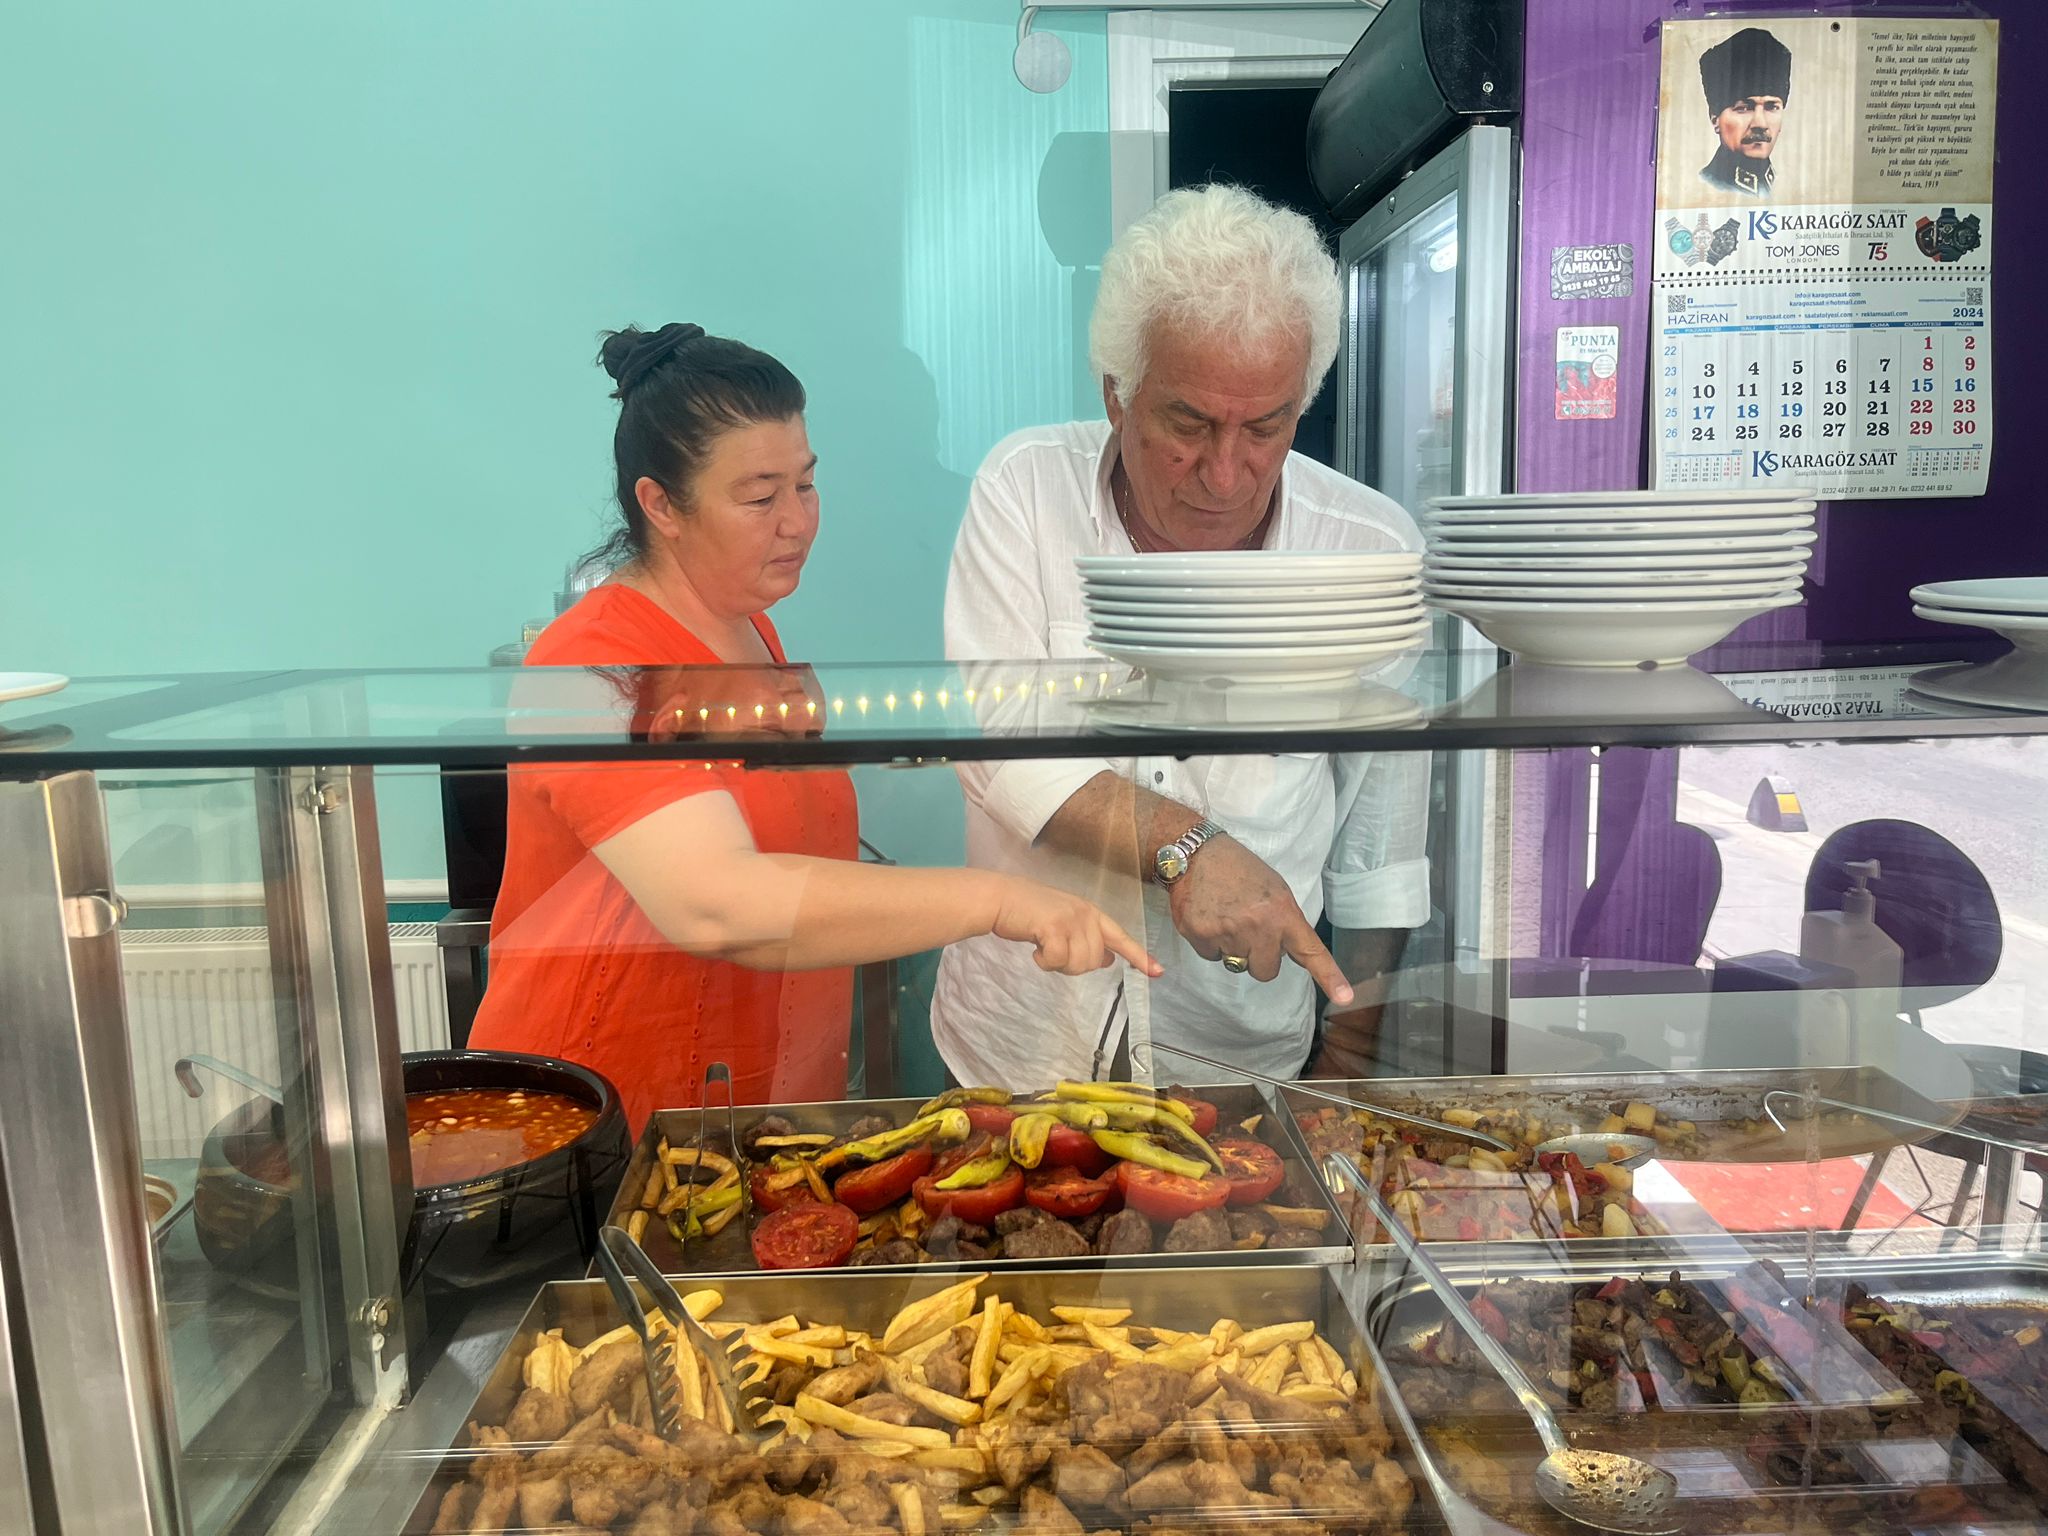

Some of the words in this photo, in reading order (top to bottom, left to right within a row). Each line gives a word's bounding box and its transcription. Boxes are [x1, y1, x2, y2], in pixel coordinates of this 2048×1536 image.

[1917, 136, 1935, 144] yüksek
[1872, 147, 1886, 155] Böyle
[1889, 159, 1898, 167] yok
[1781, 211, 1862, 230] KARAGÖZ
[1867, 213, 1907, 229] SAAT
[1574, 249, 1611, 261] EKOL
[1766, 245, 1794, 257] TOM
[1799, 245, 1839, 257] JONES
[1563, 261, 1621, 274] AMBALAJ
[1668, 312, 1728, 325] HAZİRAN
[1746, 313, 1795, 321] karagozsaat.com
[1952, 308, 1984, 318] 2024
[1571, 335, 1616, 346] PUNTA
[1664, 346, 1676, 355] 22
[1924, 336, 1932, 349] 1
[1965, 336, 1975, 349] 2
[1664, 367, 1676, 376] 23
[1704, 364, 1715, 377] 3
[1748, 362, 1759, 375] 4
[1793, 360, 1803, 374] 5
[1836, 360, 1846, 373] 6
[1880, 359, 1890, 372] 7
[1923, 357, 1933, 371] 8
[1965, 357, 1975, 371] 9
[1665, 388, 1677, 396] 24
[1693, 385, 1715, 398] 10
[1737, 384, 1758, 396] 11
[1781, 382, 1803, 395] 12
[1825, 381, 1846, 394] 13
[1869, 380, 1890, 393] 14
[1912, 379, 1933, 392] 15
[1955, 378, 1975, 391] 16
[1665, 408, 1677, 417] 25
[1693, 406, 1715, 419] 17
[1737, 404, 1759, 418] 18
[1781, 403, 1803, 416] 19
[1824, 402, 1846, 415] 20
[1867, 401, 1888, 414] 21
[1911, 400, 1933, 413] 22
[1954, 400, 1975, 413] 23
[1665, 429, 1677, 438] 26
[1692, 427, 1715, 441] 24
[1736, 426, 1758, 439] 25
[1780, 424, 1802, 438] 26
[1823, 424, 1845, 437] 27
[1867, 422, 1889, 436] 28
[1910, 421, 1932, 434] 29
[1953, 421, 1975, 434] 30
[1782, 451, 1855, 468] KARAGÖZ
[1859, 453, 1897, 466] SAAT
